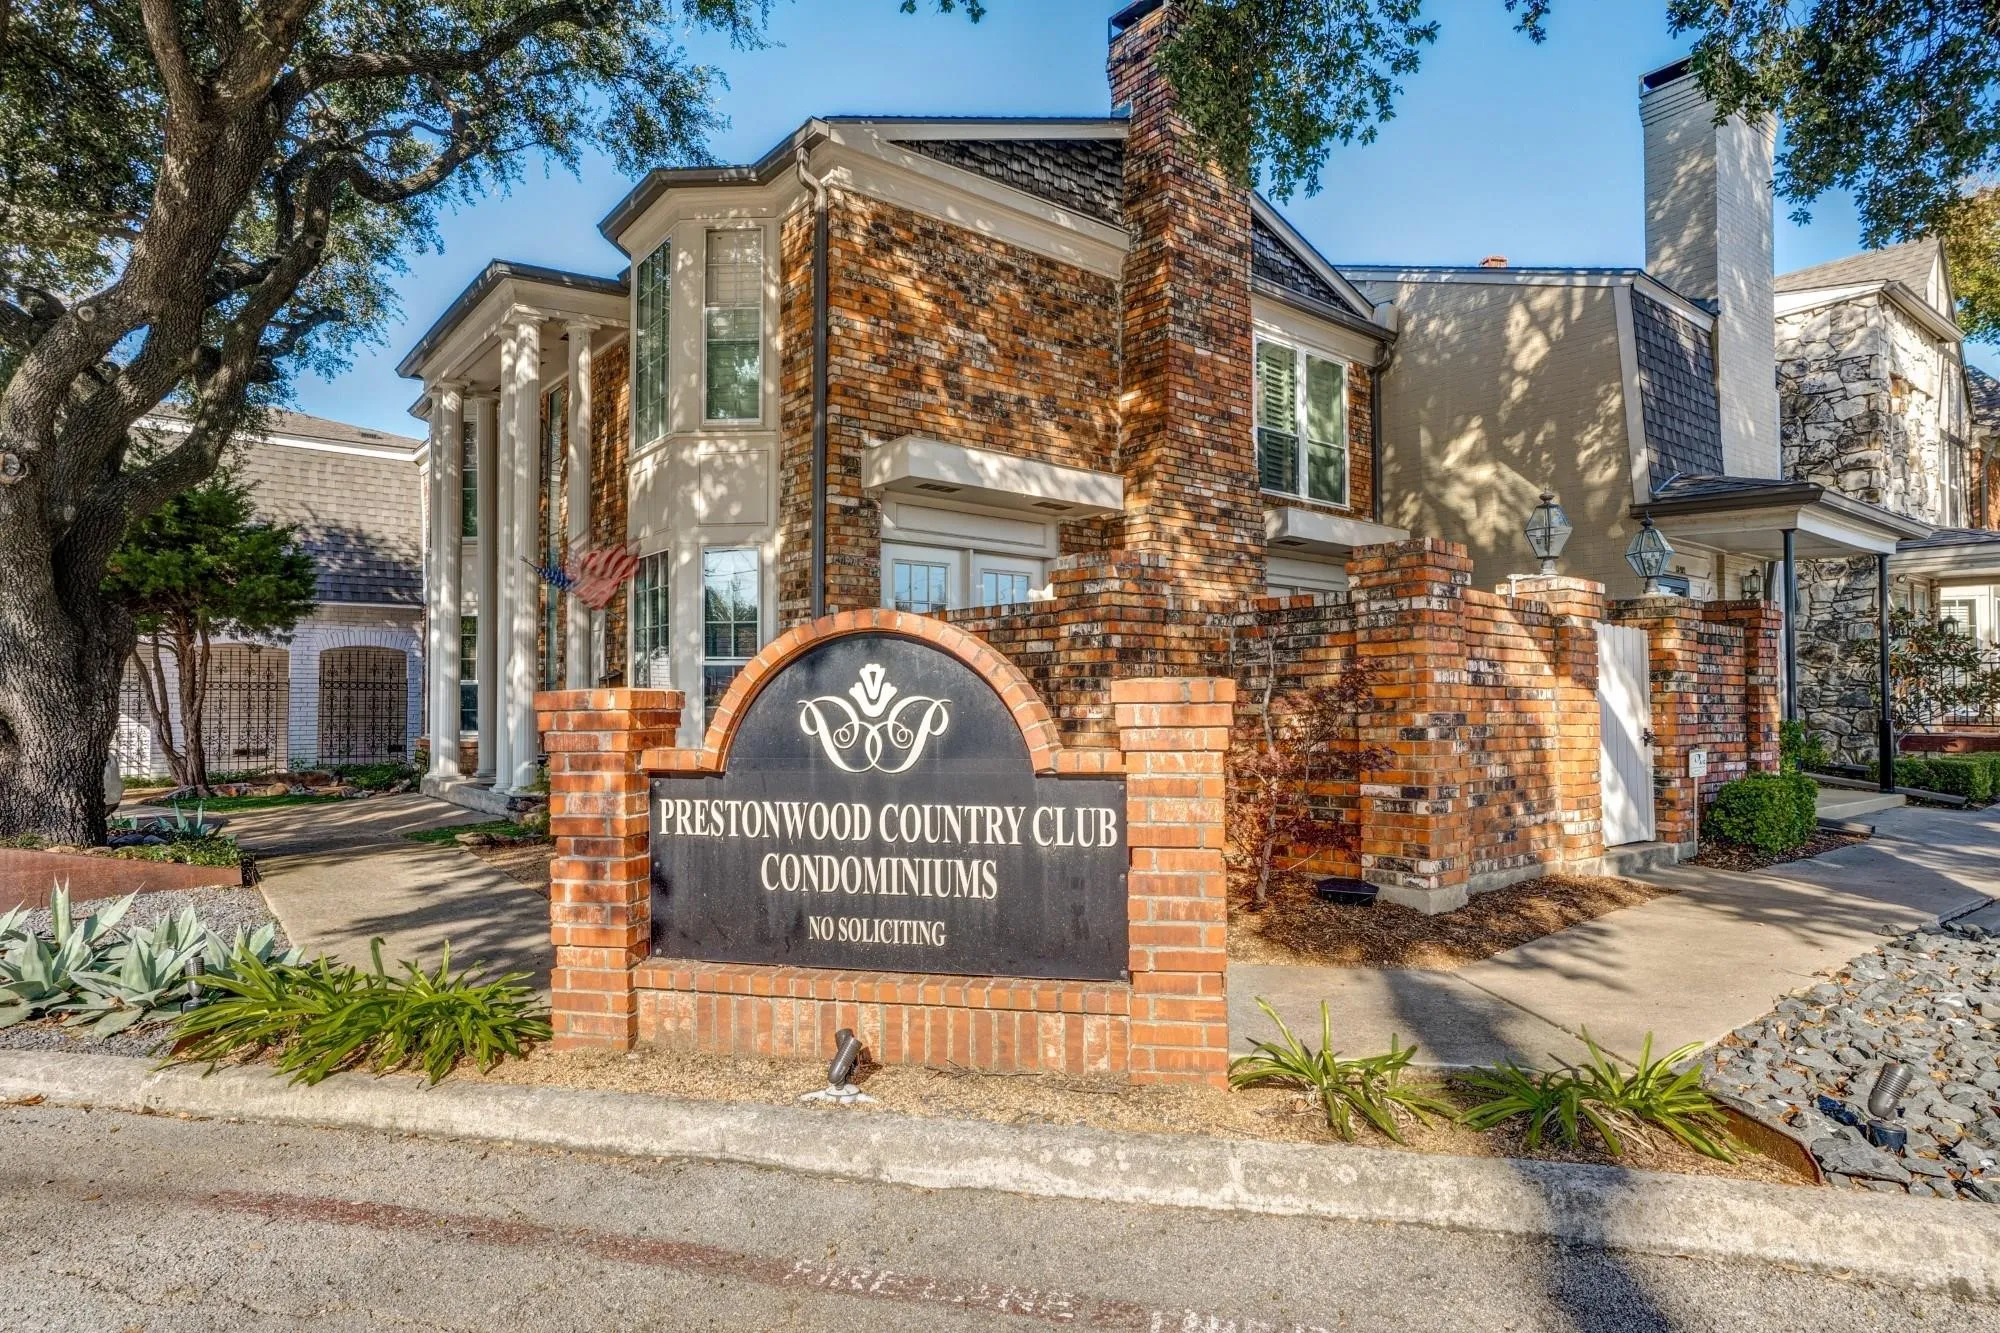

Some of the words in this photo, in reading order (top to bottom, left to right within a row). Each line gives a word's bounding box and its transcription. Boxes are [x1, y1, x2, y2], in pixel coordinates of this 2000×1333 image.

[658, 798, 872, 842] PRESTONWOOD
[878, 802, 1026, 846] COUNTRY
[1031, 805, 1119, 849] CLUB
[760, 852, 999, 901] CONDOMINIUMS
[808, 915, 835, 942] NO
[838, 916, 946, 948] SOLICITING
[783, 1258, 903, 1295] FIRE
